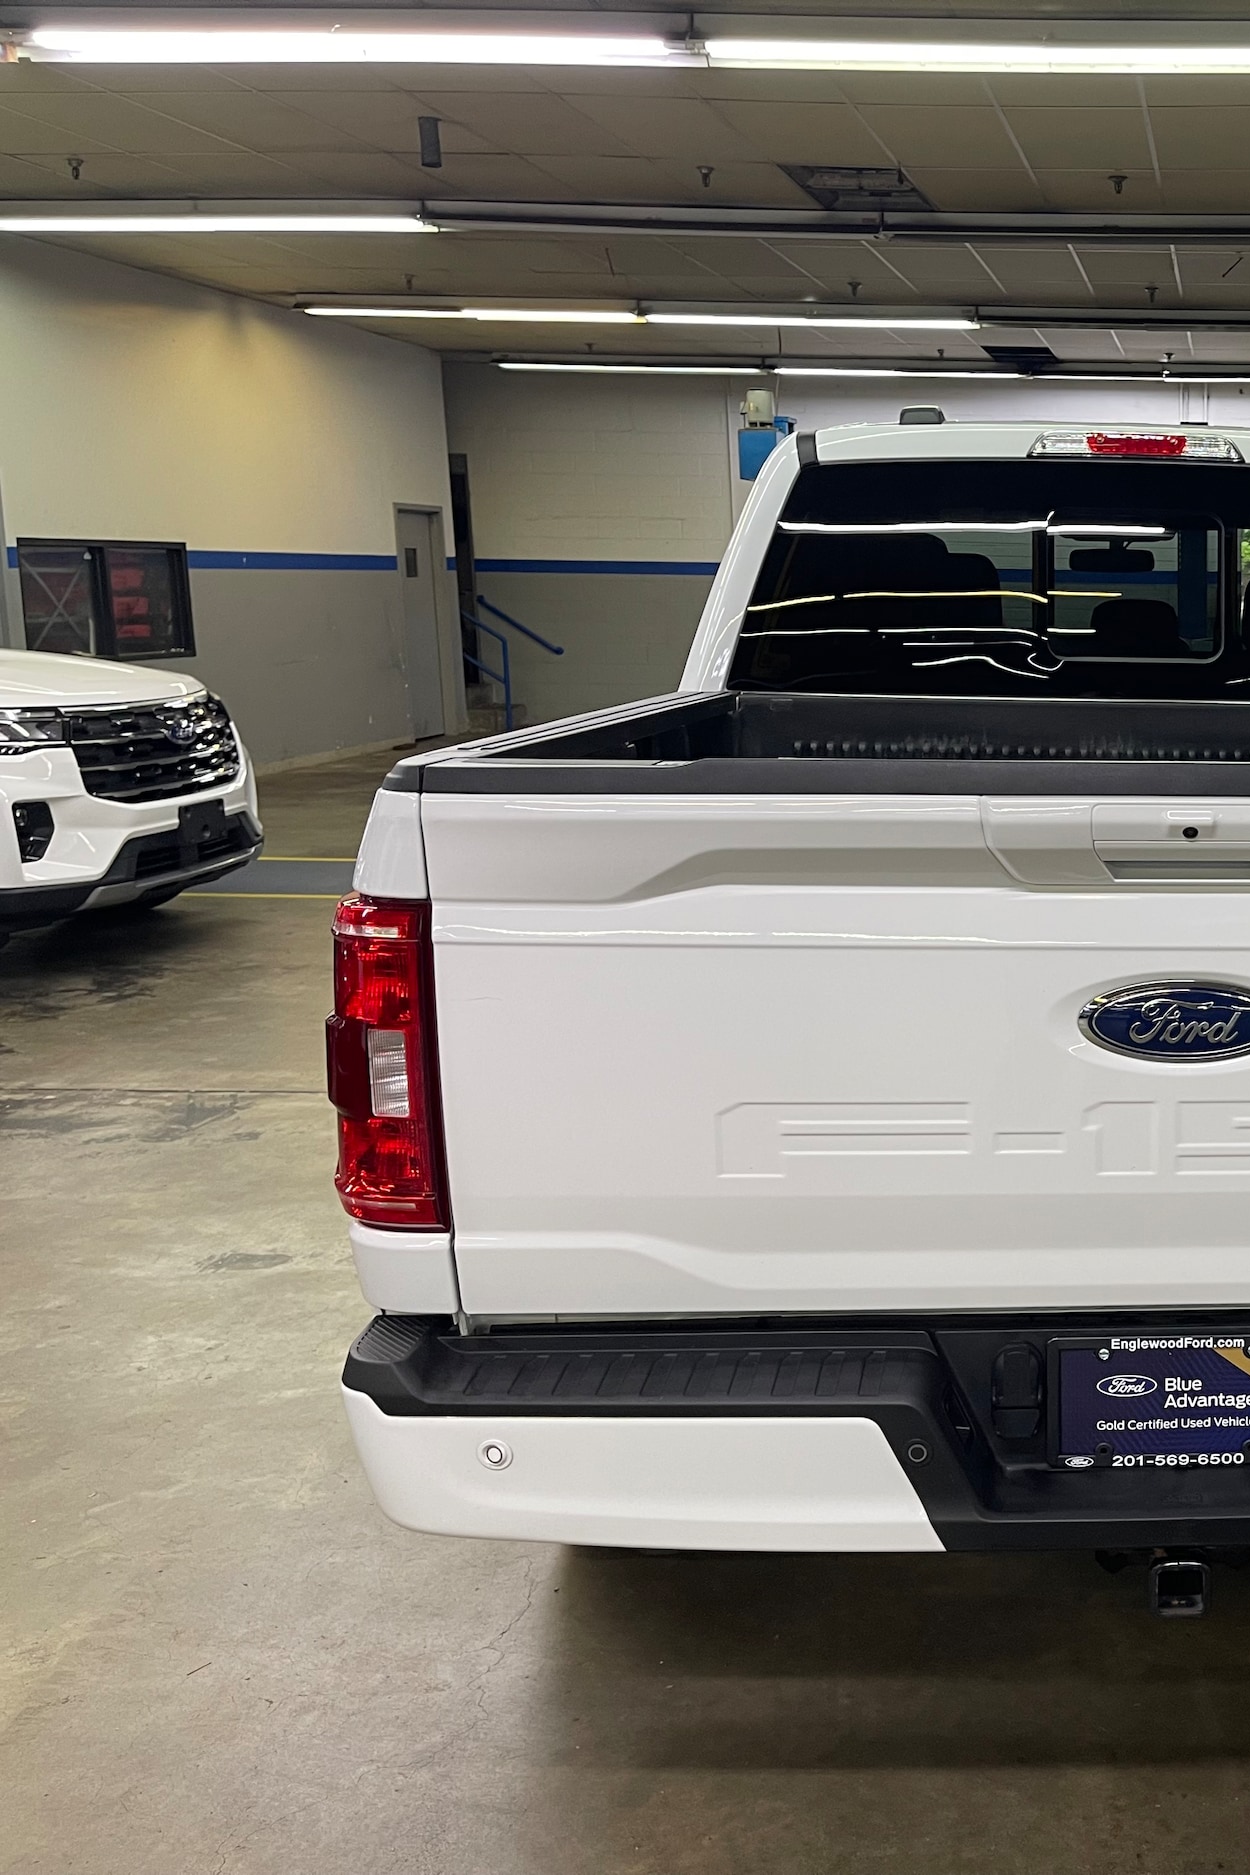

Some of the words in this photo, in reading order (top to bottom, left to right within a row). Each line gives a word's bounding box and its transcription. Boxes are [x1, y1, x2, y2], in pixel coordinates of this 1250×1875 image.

[1129, 998, 1242, 1044] Ford
[1110, 1337, 1245, 1351] EnglewoodFord.com
[1107, 1377, 1146, 1394] Ford
[1164, 1377, 1203, 1392] Blue
[1096, 1420, 1125, 1431] Gold
[1127, 1418, 1179, 1431] Certified
[1180, 1418, 1211, 1429] Used
[1111, 1453, 1245, 1467] 201-569-6500
